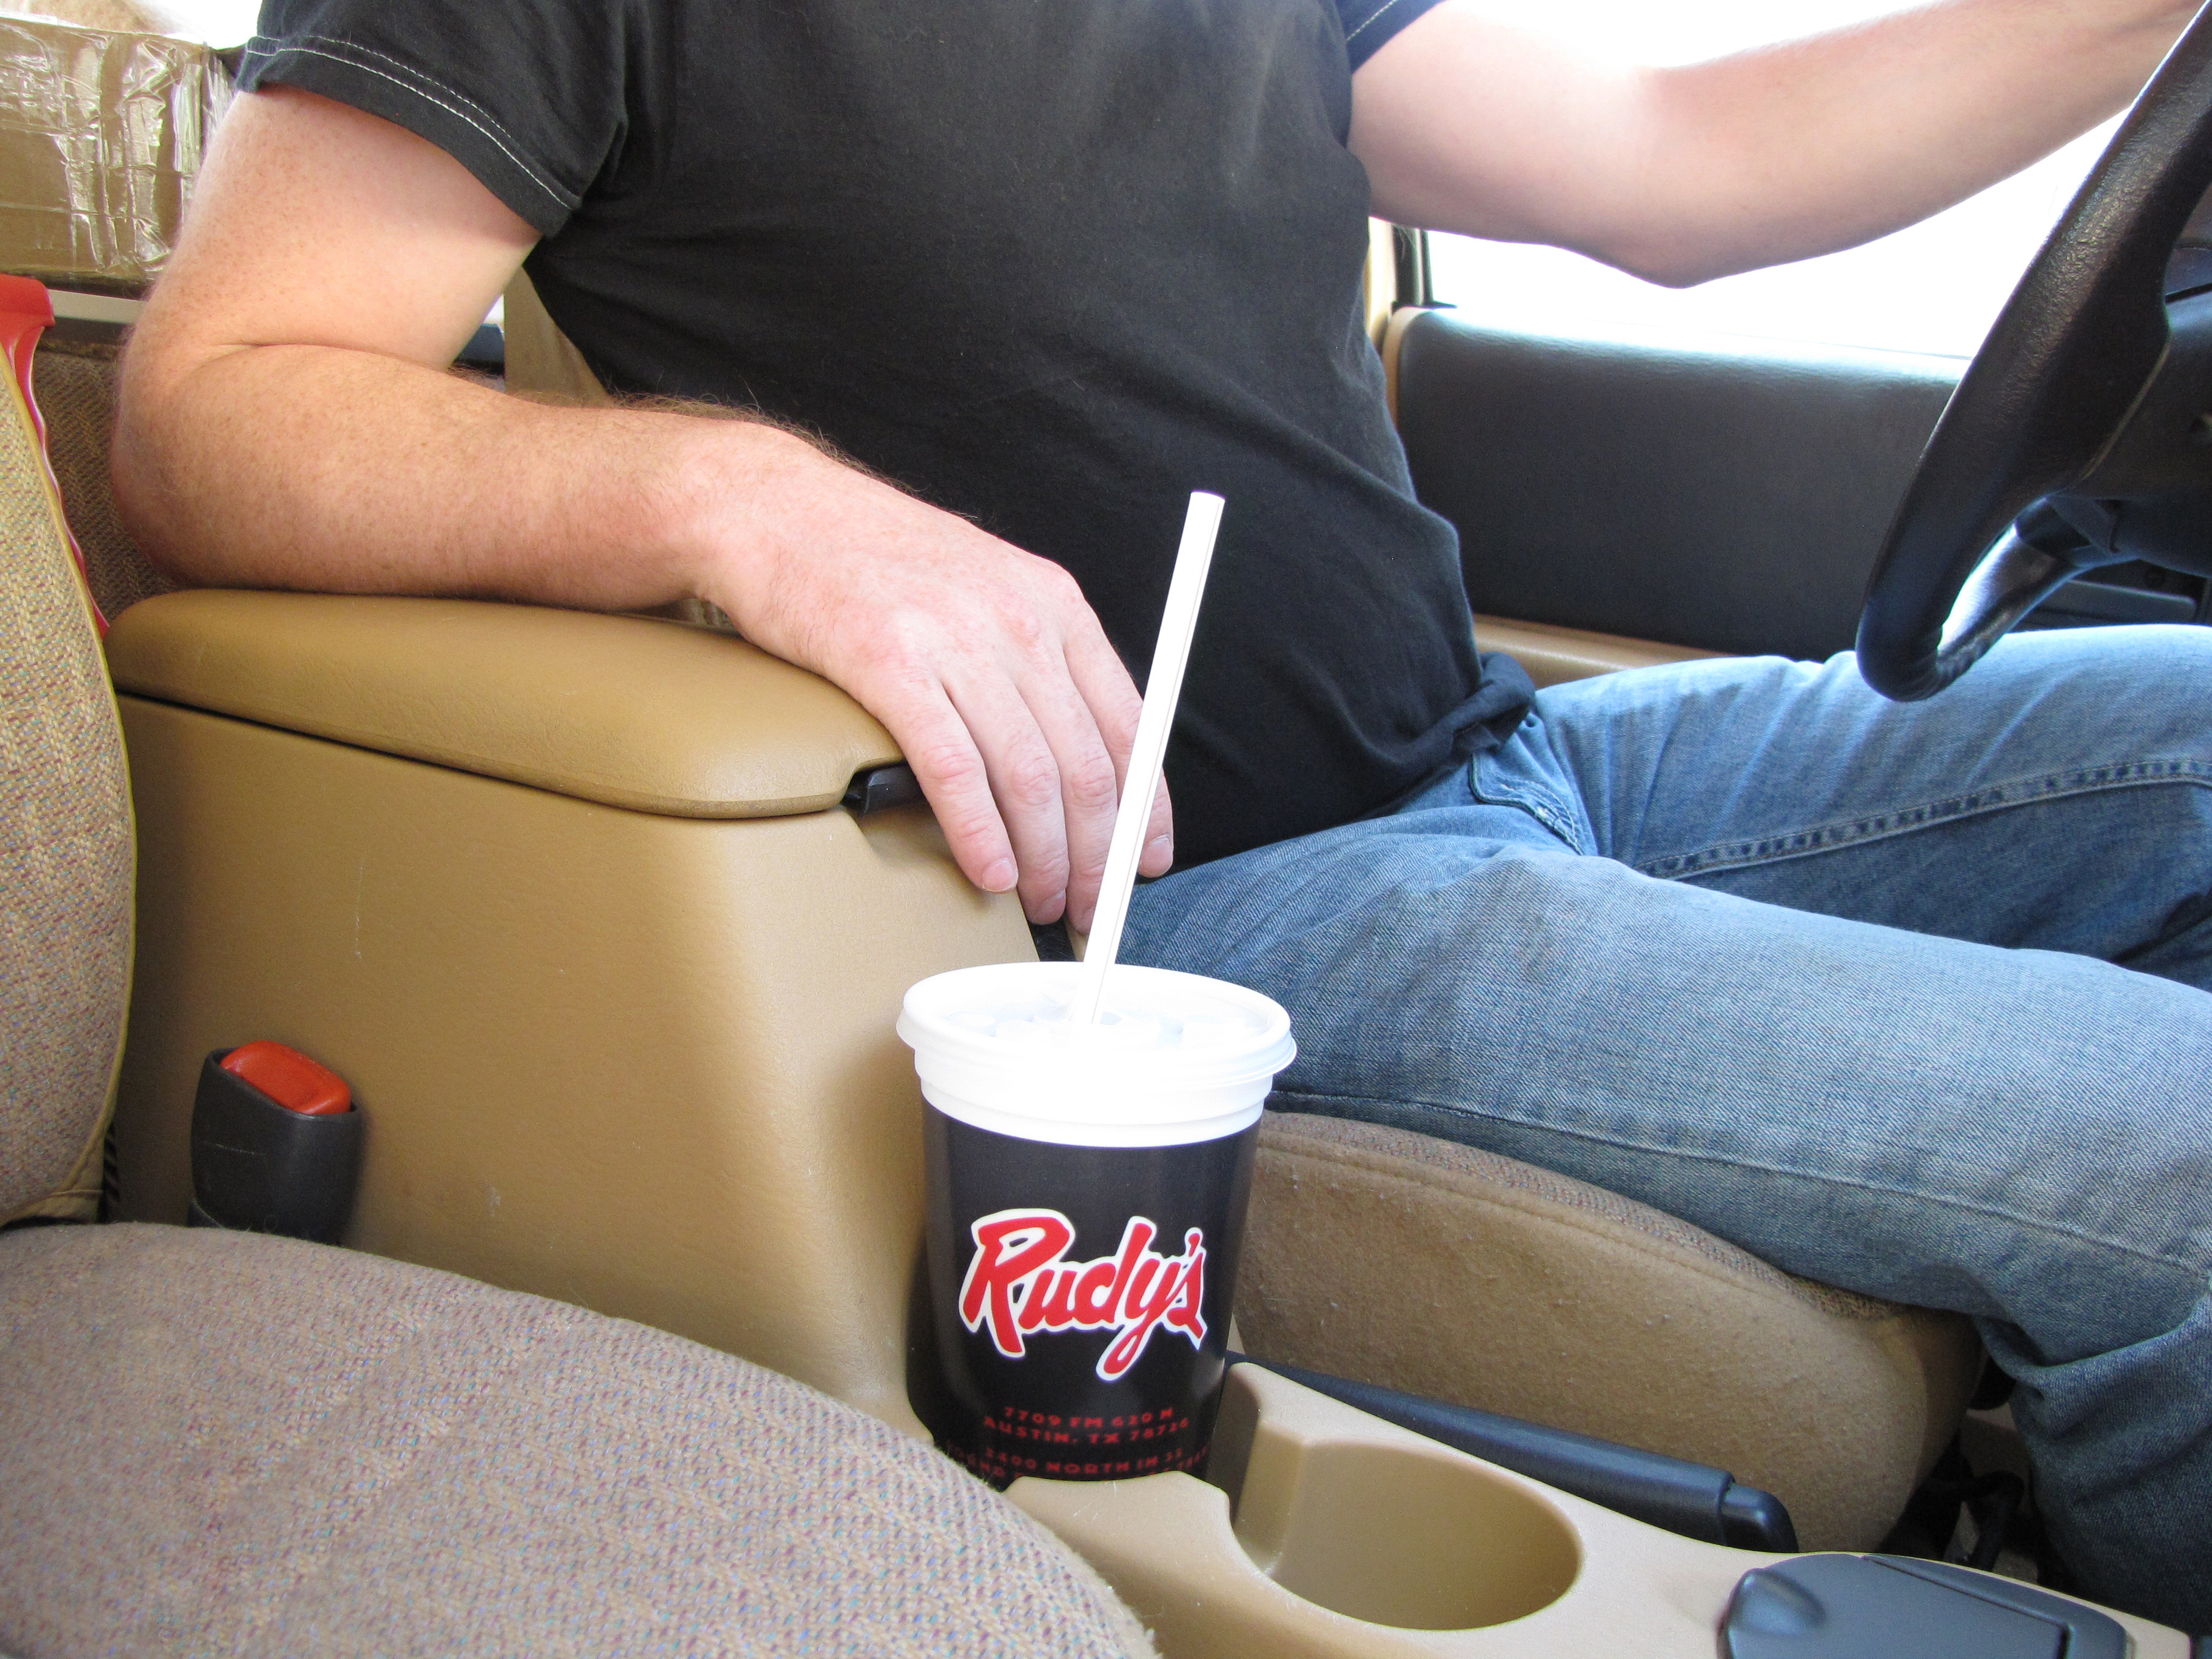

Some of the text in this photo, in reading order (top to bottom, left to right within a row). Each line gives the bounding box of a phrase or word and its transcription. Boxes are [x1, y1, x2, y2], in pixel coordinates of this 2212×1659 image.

[959, 1208, 1207, 1381] Rudy's
[1005, 1407, 1174, 1428] 7709 FM 620 N
[1089, 1433, 1119, 1444] TX
[1046, 1461, 1130, 1474] NORTH
